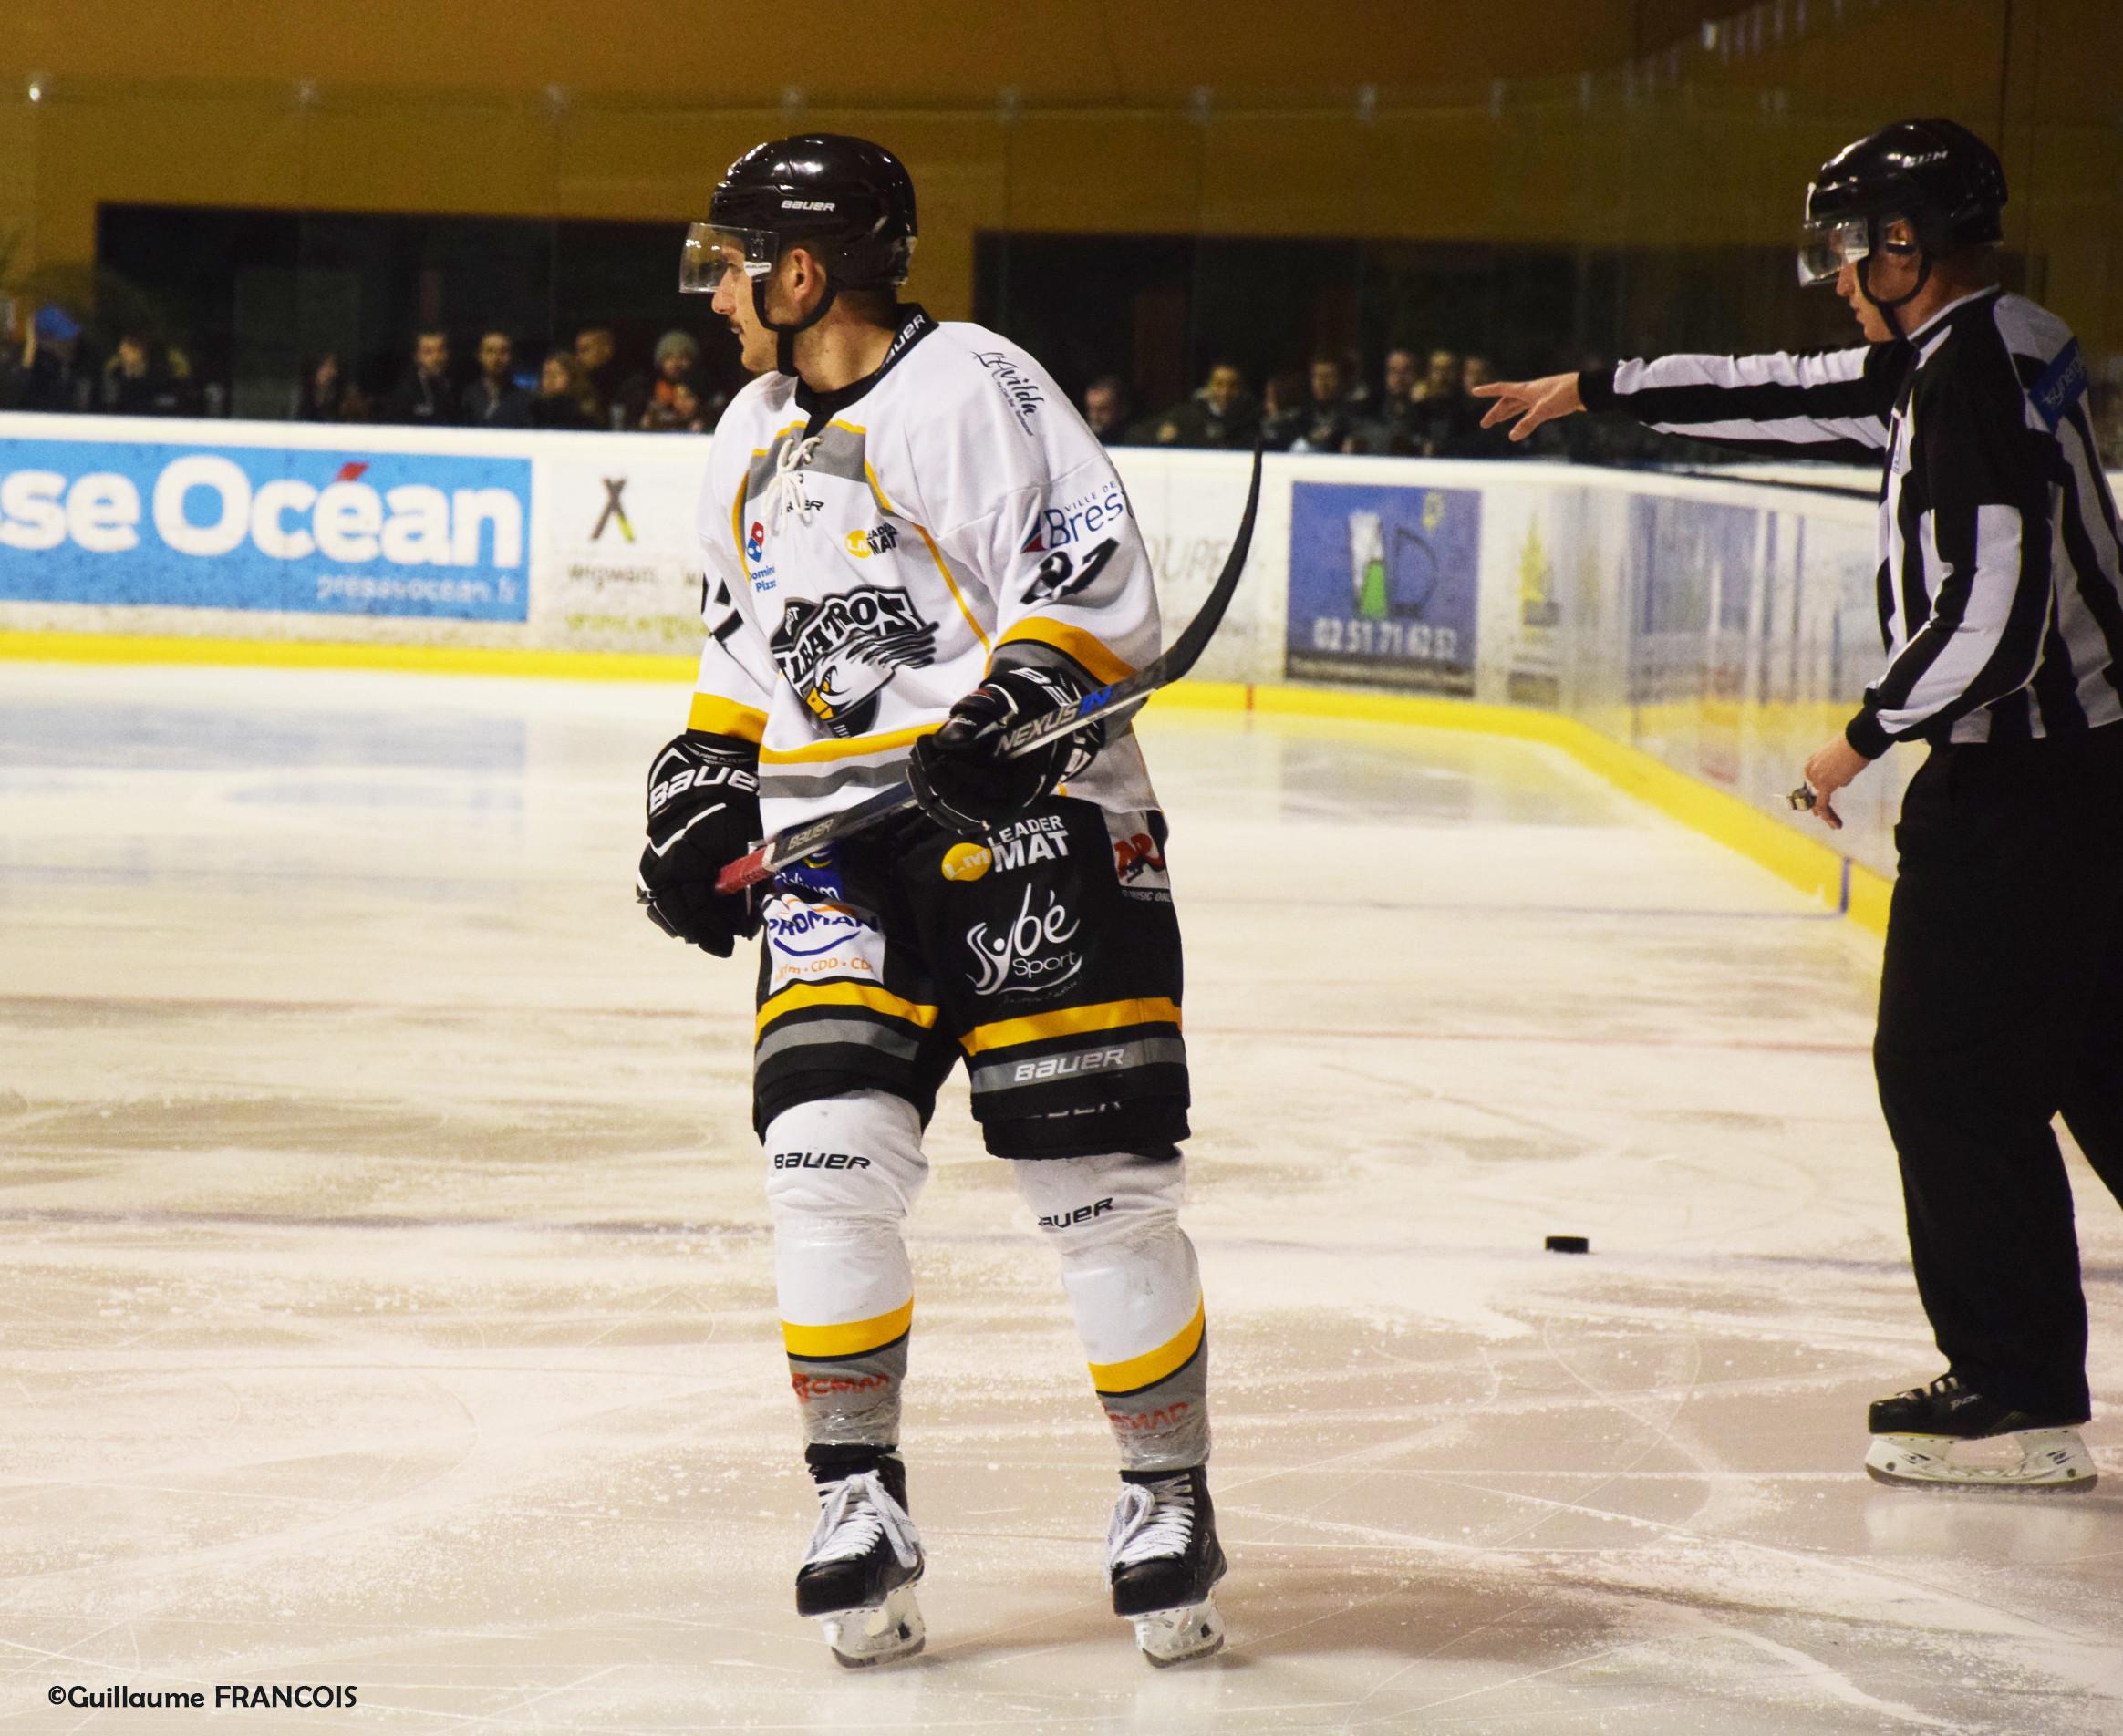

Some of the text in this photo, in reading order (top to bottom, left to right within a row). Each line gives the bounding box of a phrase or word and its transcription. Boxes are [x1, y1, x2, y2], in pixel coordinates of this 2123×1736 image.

[781, 200, 836, 212] BAUER
[152, 454, 523, 569] Océan
[1064, 480, 1118, 512] VILLE DE
[867, 531, 898, 556] MAT
[993, 701, 1080, 757] NEXUS
[648, 765, 761, 816] BAUE
[787, 819, 834, 852] BAUER
[987, 815, 1065, 848] LEADER
[991, 831, 1070, 873] MAT
[810, 957, 839, 974] CDD
[1012, 950, 1076, 979] Sport
[1013, 1049, 1124, 1082] BAUER
[1038, 1197, 1113, 1228] AUER
